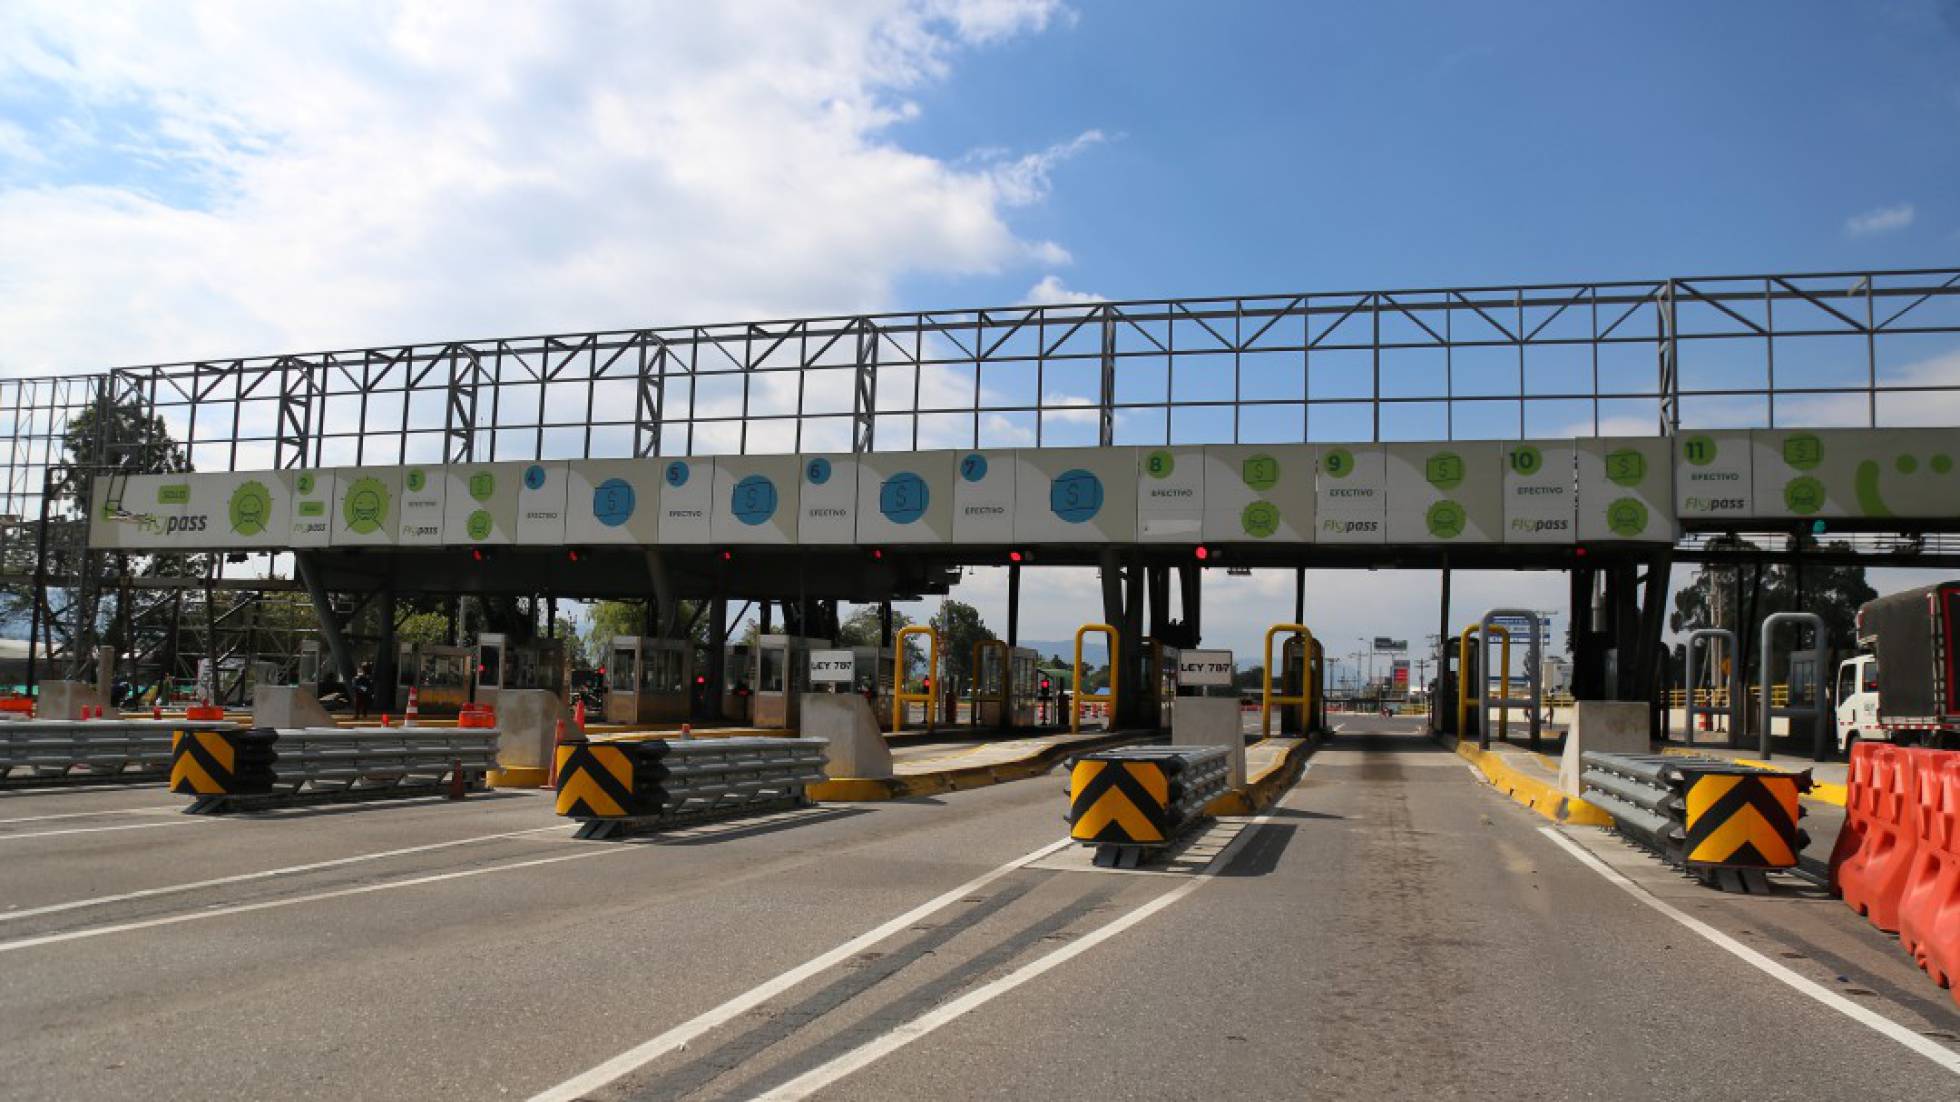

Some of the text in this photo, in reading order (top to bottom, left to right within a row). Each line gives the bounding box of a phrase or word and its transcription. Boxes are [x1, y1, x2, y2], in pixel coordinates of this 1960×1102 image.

[1686, 442, 1705, 460] 11
[964, 460, 976, 475] 7
[1150, 457, 1162, 473] 8
[1328, 456, 1341, 472] 9
[1509, 452, 1534, 470] 10
[527, 470, 536, 483] 4
[670, 467, 680, 482] 5
[810, 464, 820, 480] 6
[1691, 473, 1739, 482] EFECTIVO
[298, 478, 308, 490] 2
[1151, 488, 1194, 498] EFECTIVO
[1329, 488, 1374, 498] EFECTIVO
[1517, 486, 1563, 496] EFECTIVO
[811, 661, 831, 670] LEY
[1181, 663, 1204, 672] LEY
